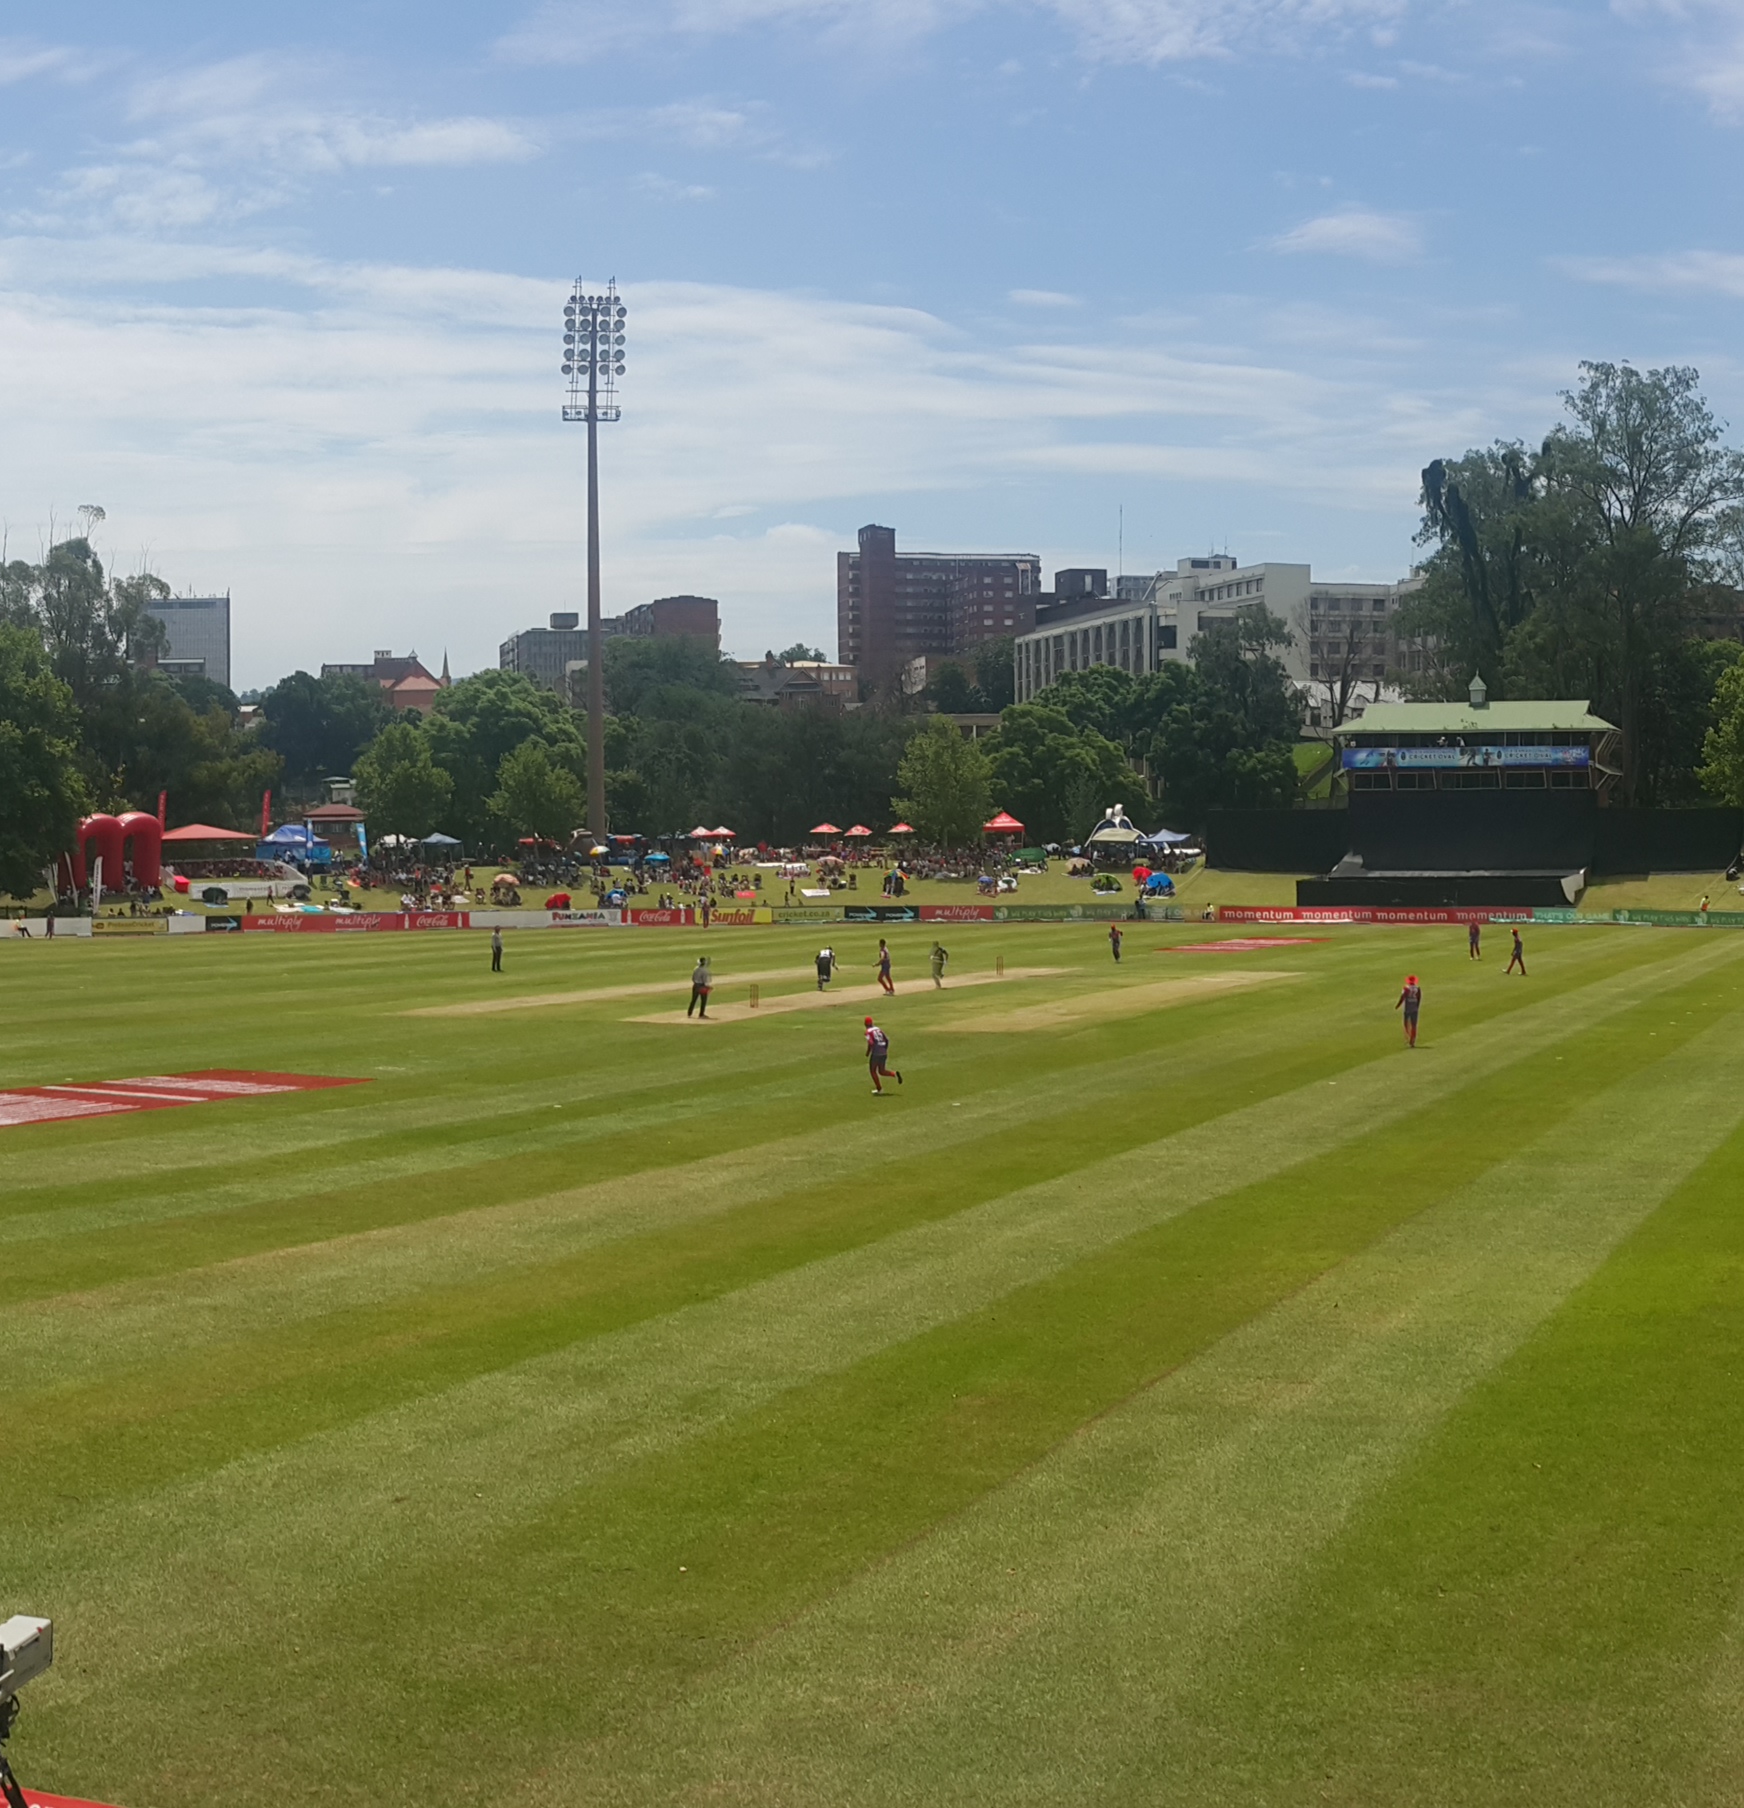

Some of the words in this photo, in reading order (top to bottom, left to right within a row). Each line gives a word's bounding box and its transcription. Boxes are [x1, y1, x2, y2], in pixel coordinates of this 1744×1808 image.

[710, 908, 755, 924] Sunfoil
[778, 909, 831, 919] cricket.co.za
[934, 907, 979, 920] multiply
[1223, 910, 1294, 920] momentum
[1301, 910, 1372, 920] momentum
[1376, 910, 1448, 921] momentum
[1456, 910, 1527, 921] momentum
[257, 915, 303, 930] multiply
[335, 915, 381, 929] multiply
